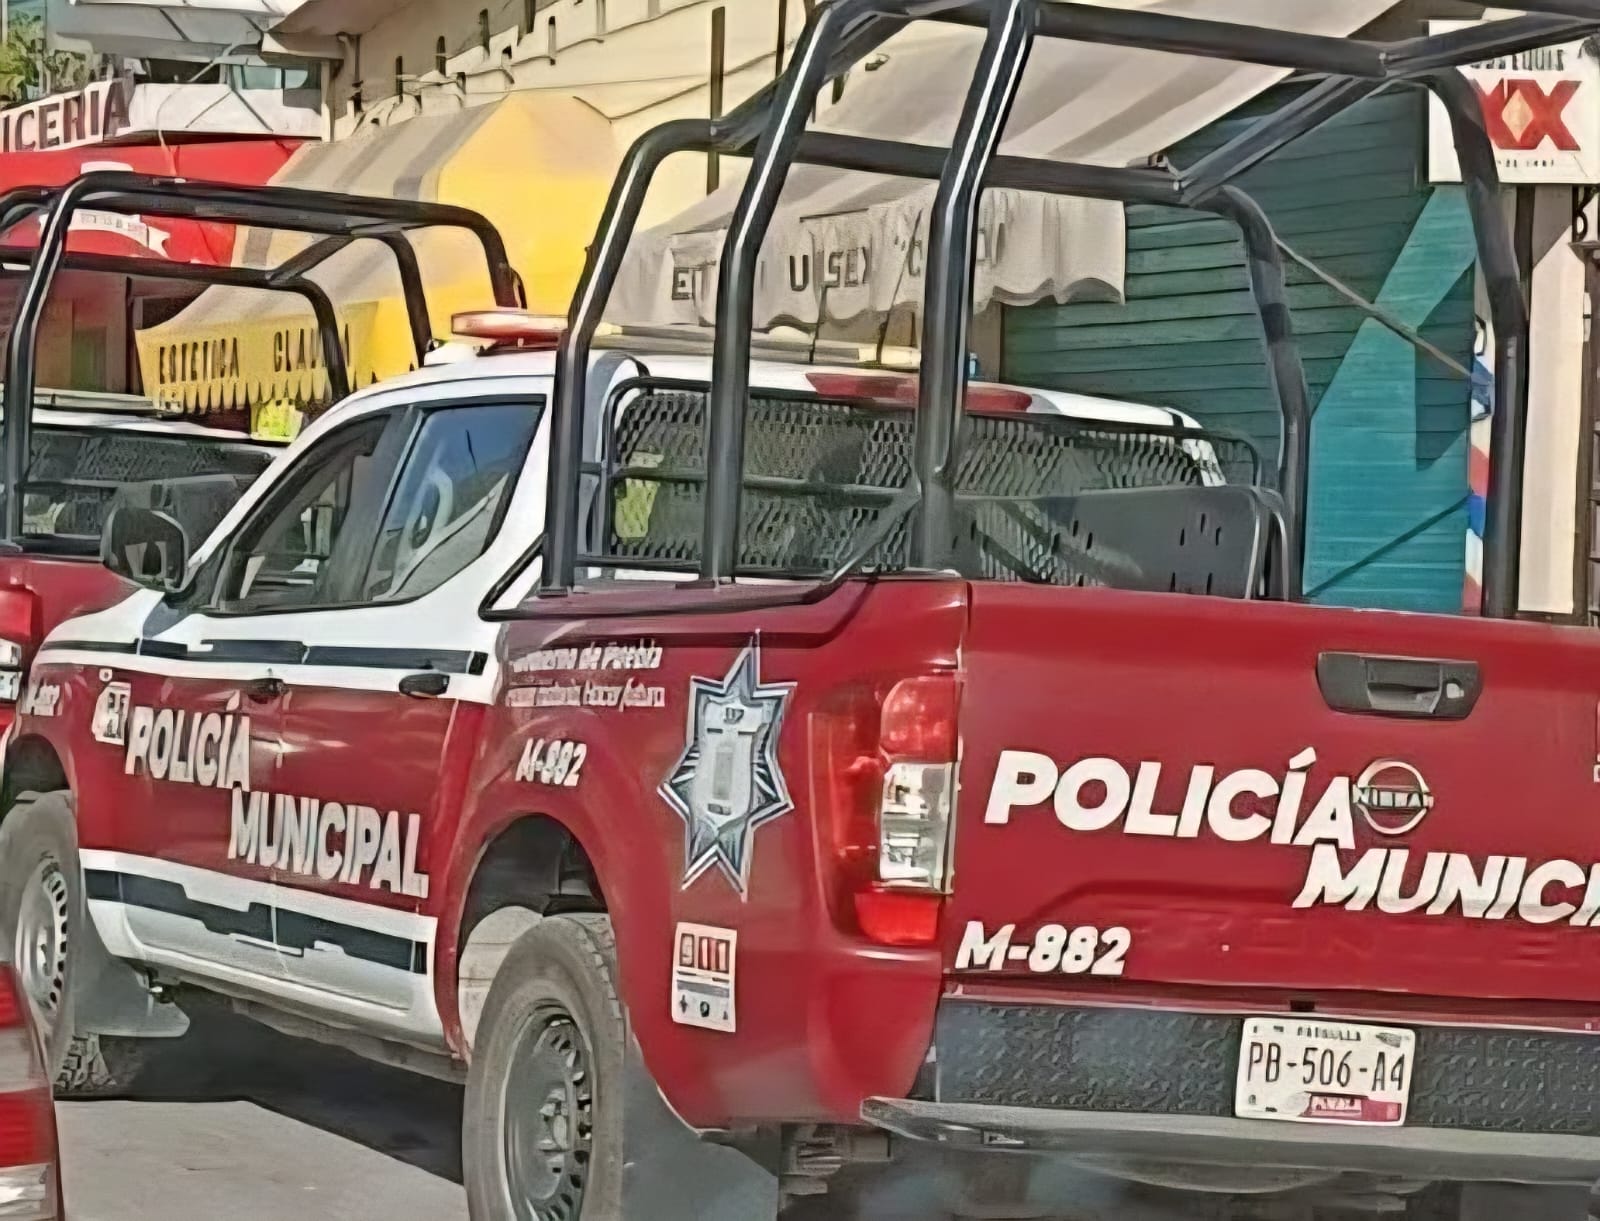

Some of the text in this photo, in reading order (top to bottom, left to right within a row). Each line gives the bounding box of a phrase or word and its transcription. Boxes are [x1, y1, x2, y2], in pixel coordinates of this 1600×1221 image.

[125, 689, 250, 792] POLICÍA
[228, 786, 429, 898] MUNICIPAL
[984, 747, 1355, 850] POLICÍA
[955, 921, 1131, 975] M-882
[1248, 1041, 1405, 1092] PB-506-A4
